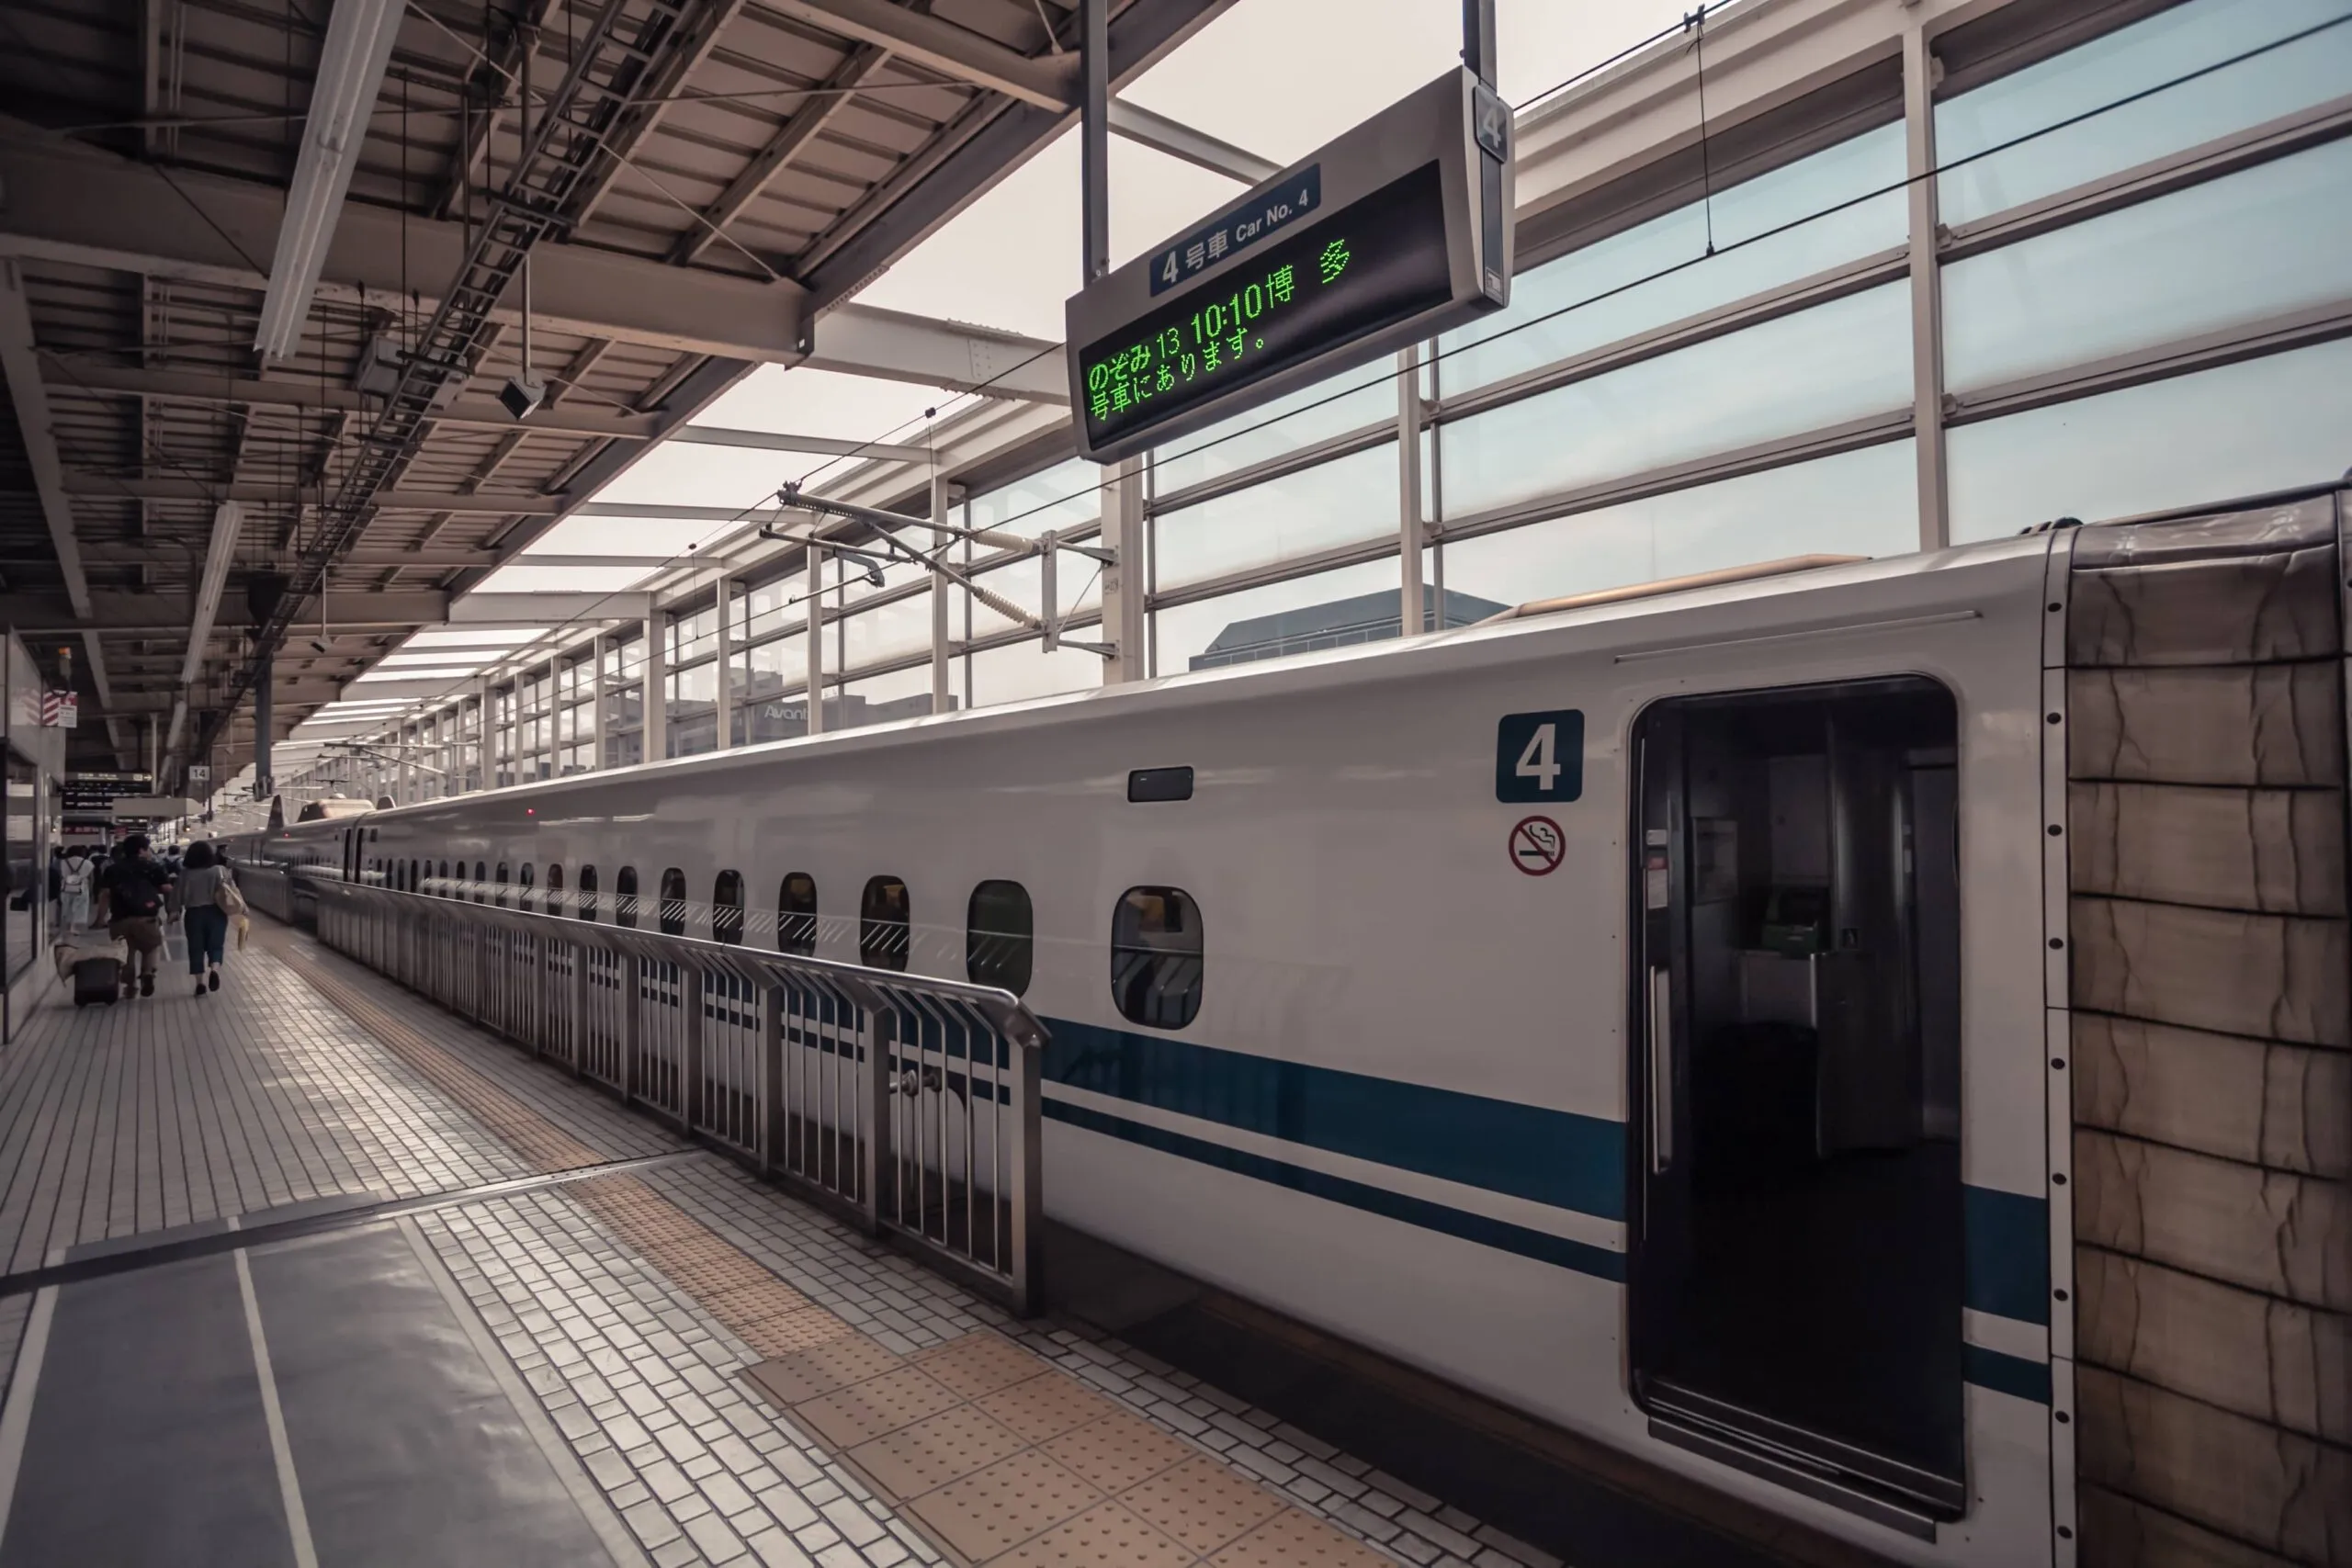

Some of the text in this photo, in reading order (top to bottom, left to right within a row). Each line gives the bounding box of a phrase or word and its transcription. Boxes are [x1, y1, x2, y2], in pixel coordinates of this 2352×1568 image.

[1482, 107, 1502, 149] 4
[1236, 220, 1262, 243] Car
[1267, 204, 1293, 227] No.
[1298, 188, 1309, 207] 4
[1089, 344, 1151, 391] のぞみ
[1157, 327, 1181, 359] 13
[1191, 283, 1262, 344] 10:10
[763, 705, 809, 721] Avant
[1515, 723, 1561, 790] 4
